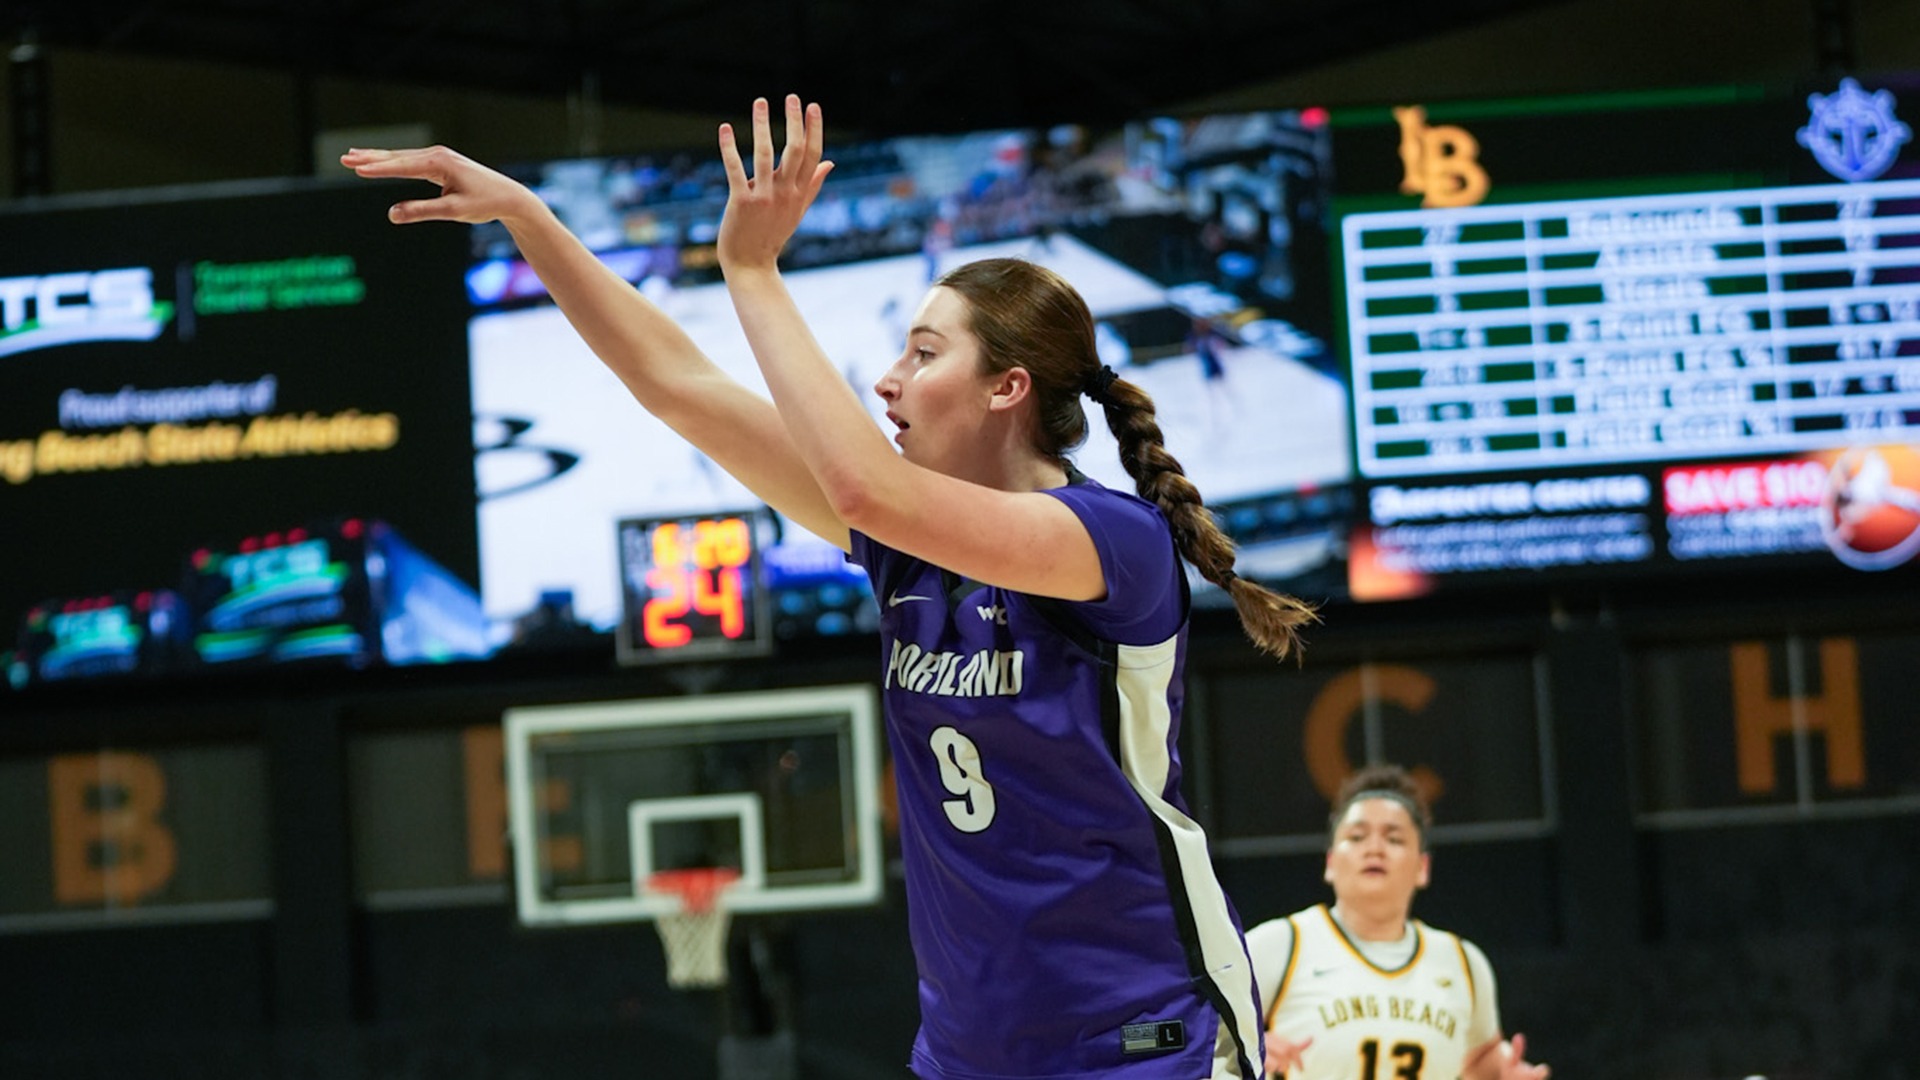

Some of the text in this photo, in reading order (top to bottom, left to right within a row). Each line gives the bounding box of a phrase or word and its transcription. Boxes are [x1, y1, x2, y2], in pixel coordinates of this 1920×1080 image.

[0, 267, 154, 332] TCS
[37, 427, 144, 474] Beach
[147, 421, 242, 466] State
[241, 408, 398, 458] Athletics
[1664, 468, 1759, 515] SAVE
[643, 567, 745, 648] 24
[885, 638, 1024, 697] PORTLAND
[1730, 636, 1866, 793] H
[929, 726, 997, 834] 9
[1165, 1027, 1175, 1042] L
[1318, 994, 1380, 1030] LONG
[1358, 1033, 1428, 1080] 13
